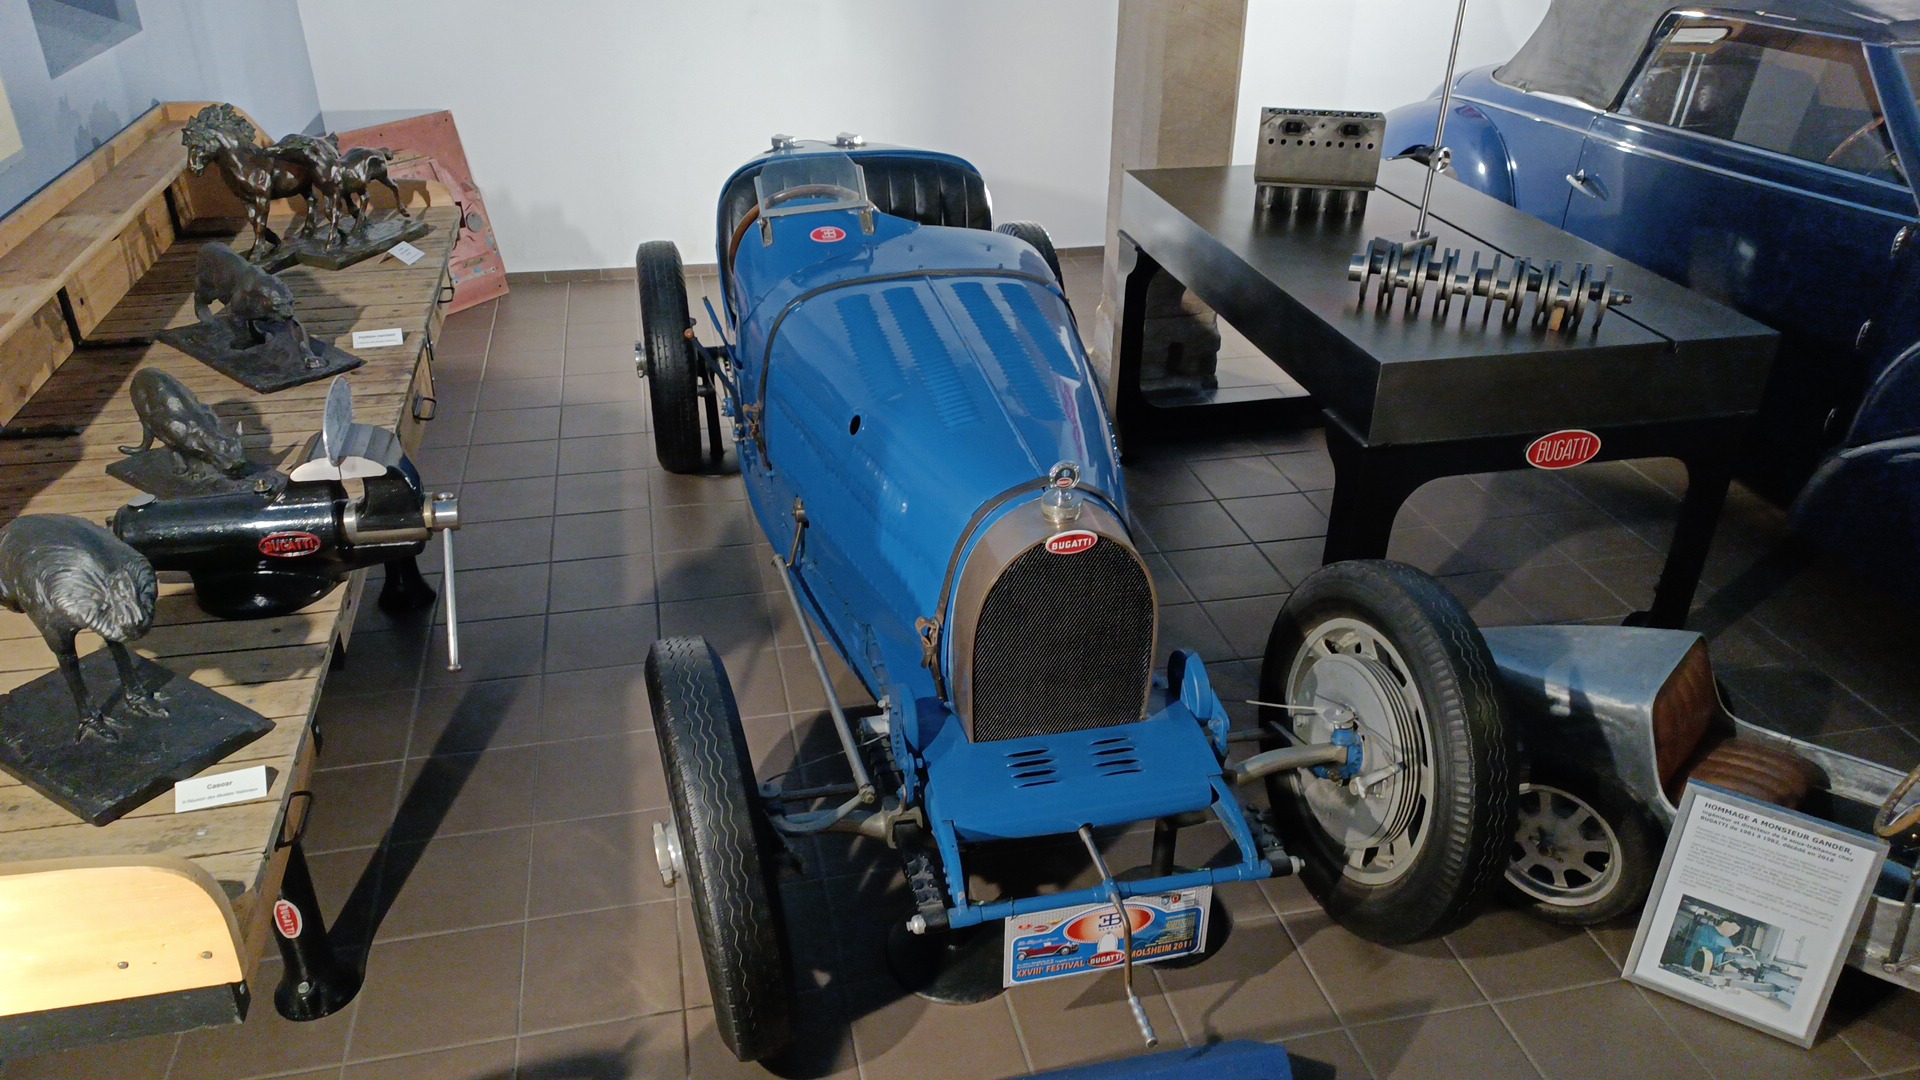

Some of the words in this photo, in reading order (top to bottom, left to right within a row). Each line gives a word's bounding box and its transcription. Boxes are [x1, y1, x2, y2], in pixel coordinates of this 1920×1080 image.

[1535, 436, 1592, 464] BUGATTI
[264, 537, 315, 553] BUGATTI
[1051, 537, 1092, 551] BUGATTI
[1700, 815, 1729, 828] BUGATTI
[1704, 801, 1750, 821] HOMMAGE
[1760, 820, 1810, 841] MONSIEUR
[1812, 837, 1853, 856] GANDER,
[1741, 822, 1771, 836] directeur
[1789, 838, 1837, 857] sous-traitance
[278, 903, 296, 935] BUGATTI
[1046, 959, 1085, 974] FESTIVAL
[1089, 953, 1123, 965] BUGATTI
[1131, 944, 1172, 958] MOLSHEIM
